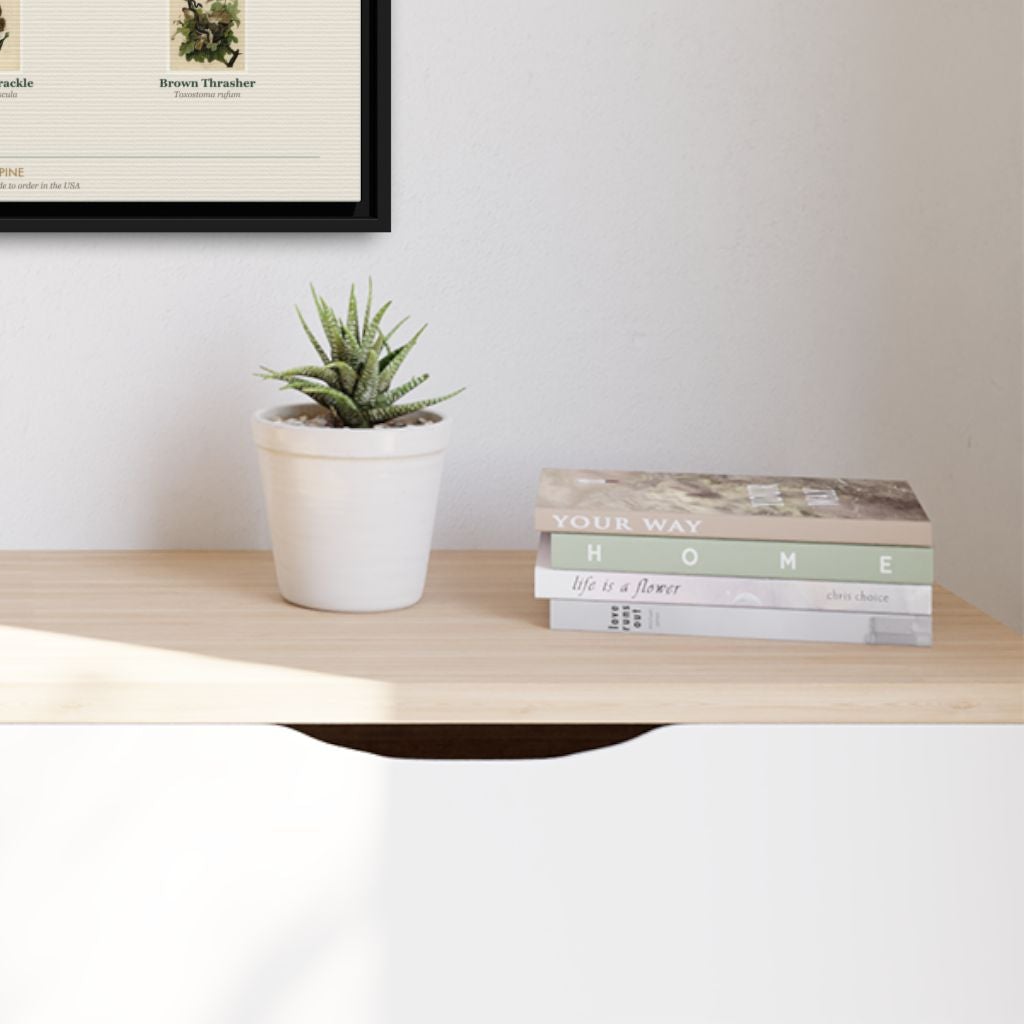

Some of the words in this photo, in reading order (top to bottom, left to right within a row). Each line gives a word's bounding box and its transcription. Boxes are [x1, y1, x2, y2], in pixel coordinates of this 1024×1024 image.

[159, 78, 199, 88] Brown
[200, 77, 257, 88] Thrasher
[0, 167, 24, 177] PINE
[8, 182, 17, 190] to
[17, 181, 39, 190] order
[40, 181, 49, 190] in
[49, 181, 63, 190] the
[63, 181, 82, 190] USA
[553, 514, 633, 531] YOUR
[643, 518, 703, 533] WAY
[587, 544, 893, 574] HOME
[571, 575, 596, 597] life
[602, 579, 614, 592] is
[620, 583, 628, 593] a
[631, 578, 682, 599] flower
[826, 589, 852, 602] chris
[854, 590, 890, 603] choice
[608, 605, 619, 629] love
[622, 605, 630, 631] runs
[632, 608, 642, 628] out
